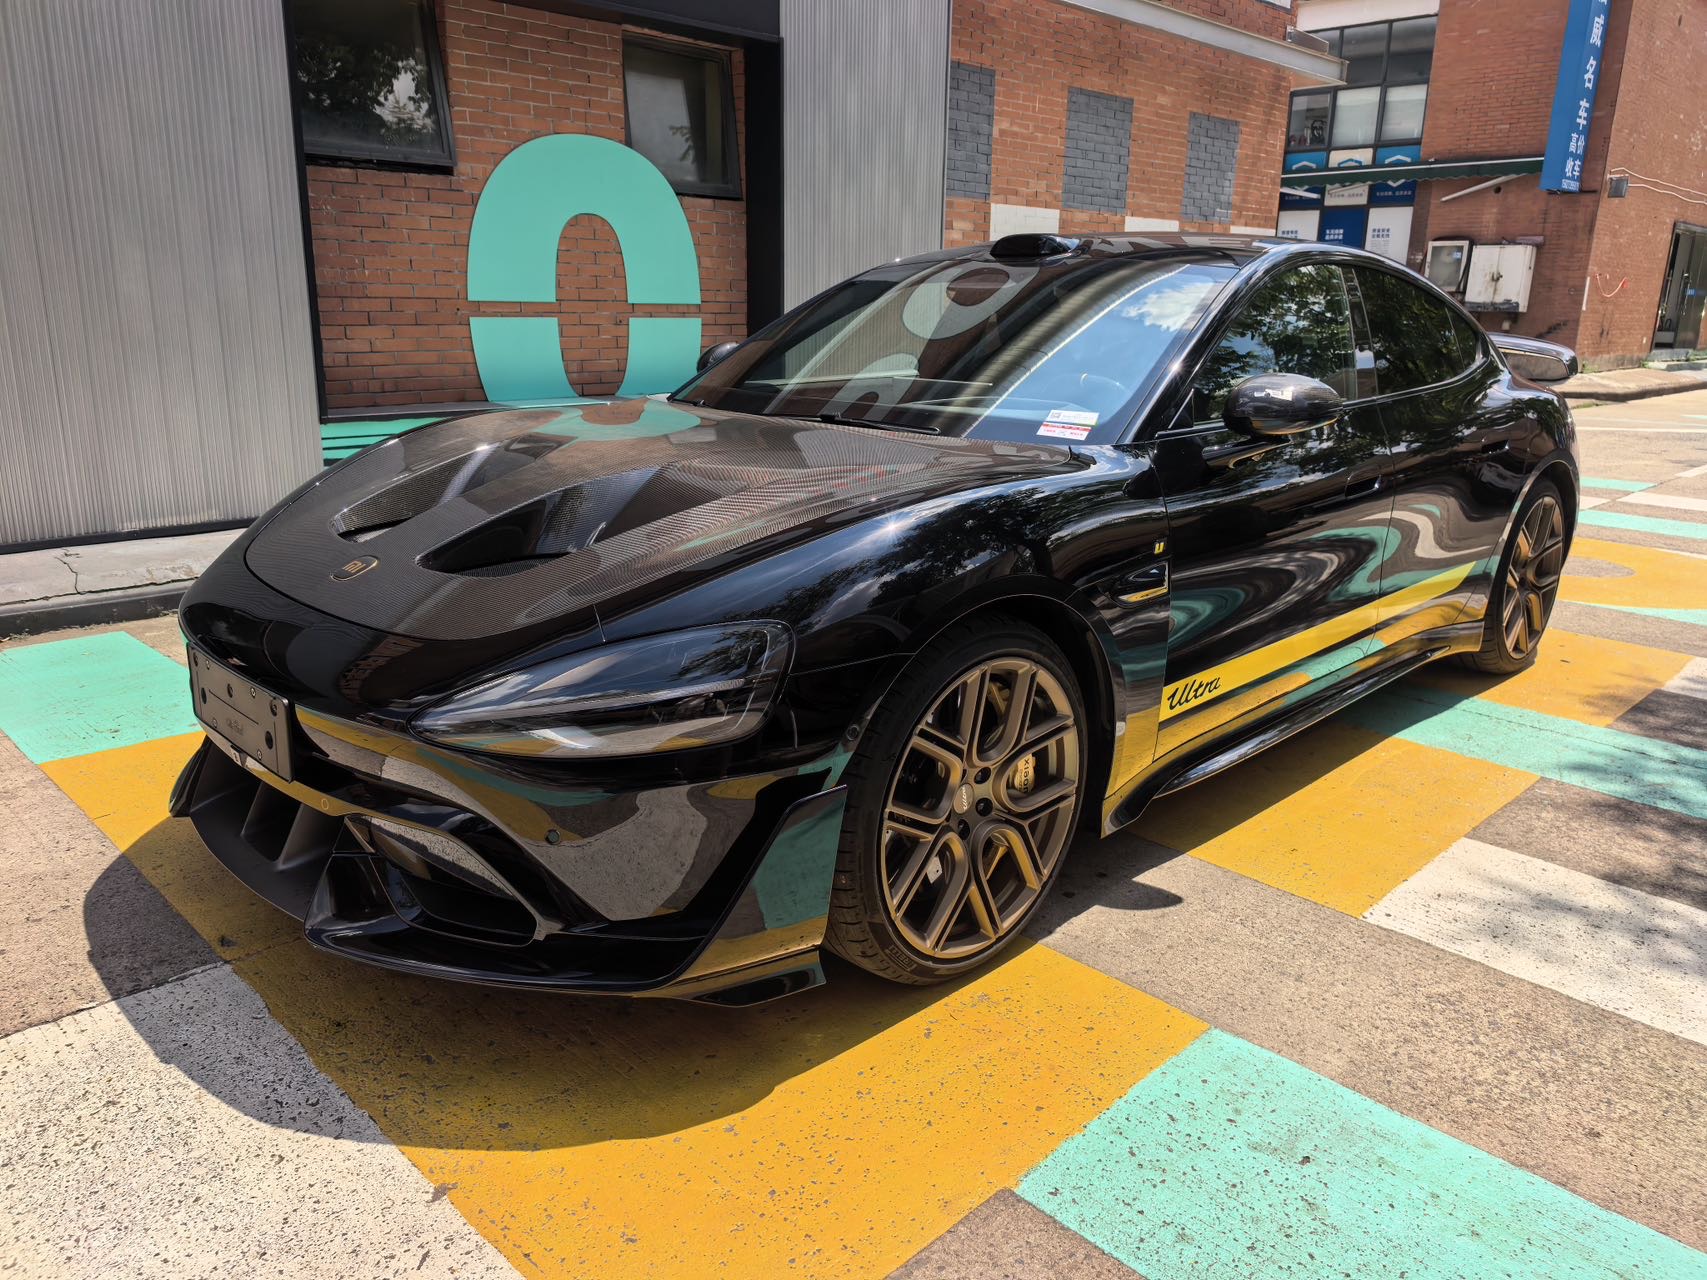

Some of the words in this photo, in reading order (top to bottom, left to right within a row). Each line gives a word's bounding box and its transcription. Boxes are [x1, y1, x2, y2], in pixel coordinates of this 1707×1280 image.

[1576, 0, 1608, 130] 威名车
[1569, 132, 1585, 155] 高价
[1565, 156, 1582, 179] 收车
[1167, 676, 1222, 711] Ultra
